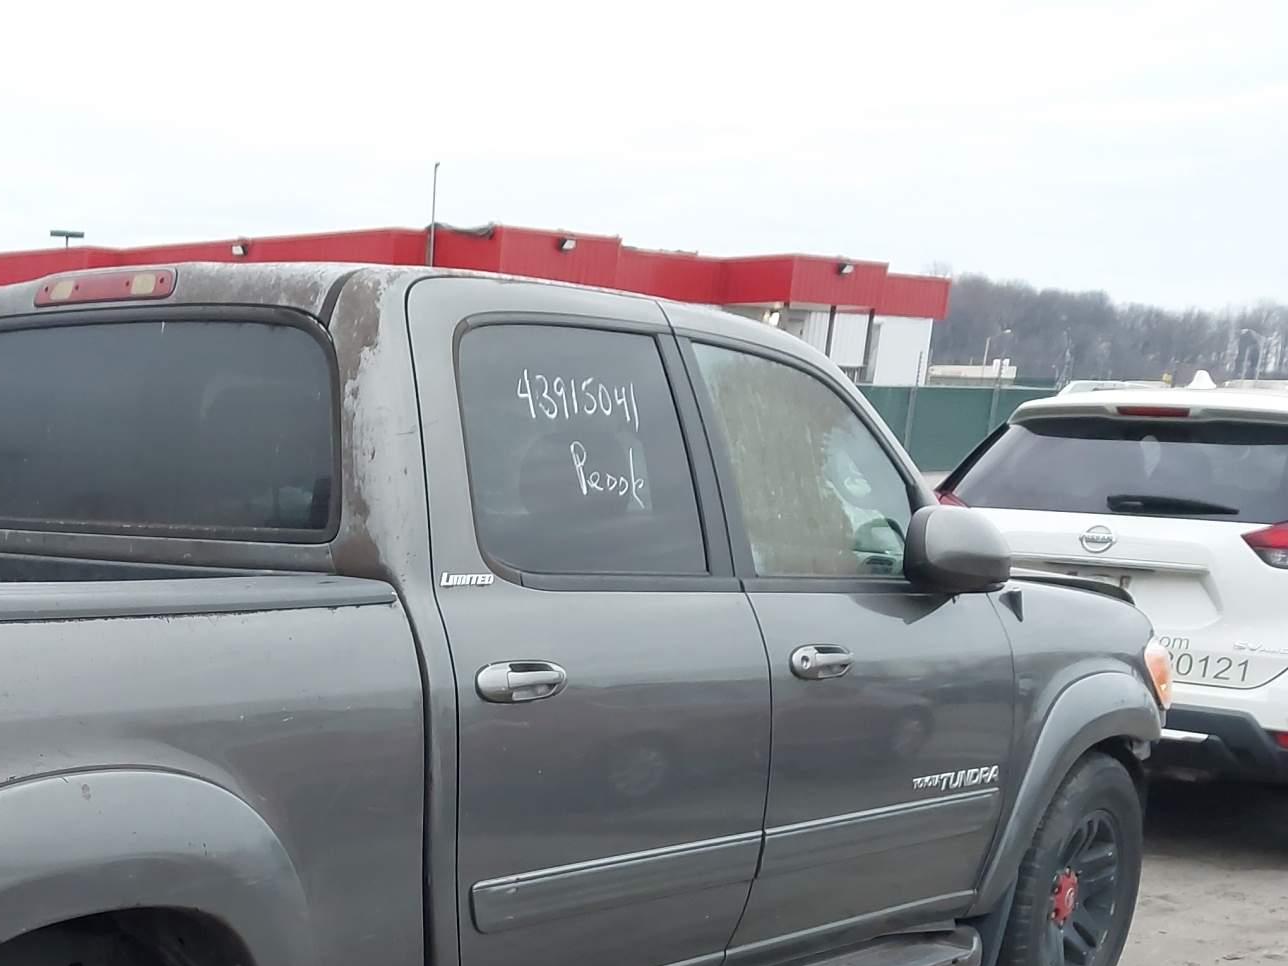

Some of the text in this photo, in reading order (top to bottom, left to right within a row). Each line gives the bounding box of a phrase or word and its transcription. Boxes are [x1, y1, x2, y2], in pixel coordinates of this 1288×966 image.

[517, 369, 639, 432] 43915041
[1168, 651, 1250, 682] 0121
[939, 764, 1000, 791] TUNDRA
